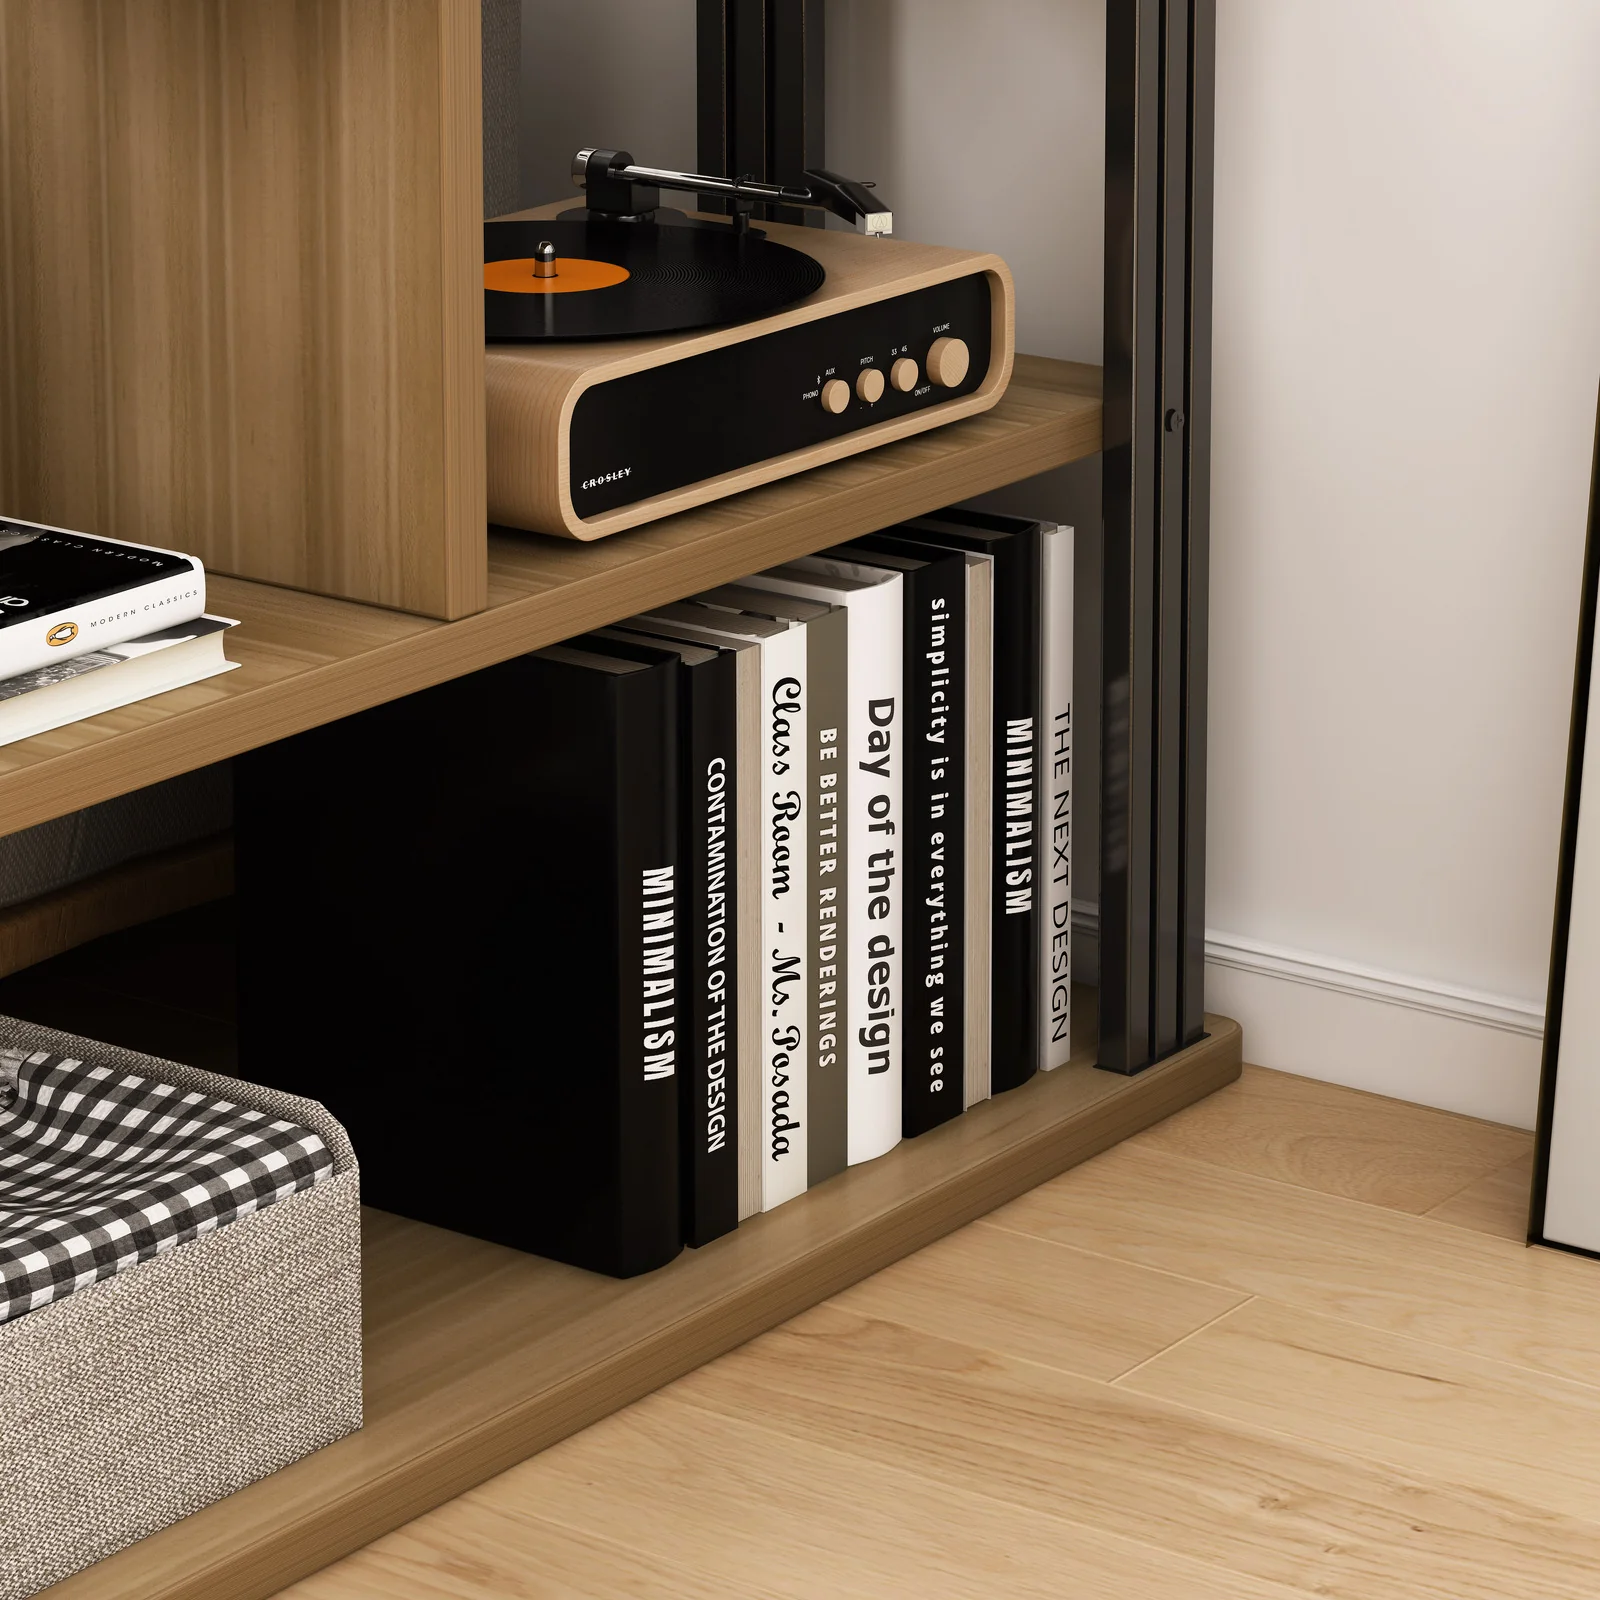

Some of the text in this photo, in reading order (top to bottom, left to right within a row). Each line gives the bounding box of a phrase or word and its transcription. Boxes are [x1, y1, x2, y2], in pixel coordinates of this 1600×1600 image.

[825, 367, 836, 377] AUX
[860, 355, 874, 366] PITCH
[932, 322, 950, 333] VOLUME
[802, 389, 819, 400] PHONO
[914, 385, 931, 397] ON/OFF
[581, 467, 632, 490] CROSLEY
[90, 589, 198, 628] MODERN CLASSICS
[772, 676, 802, 776] Class
[771, 790, 802, 900] Room
[925, 598, 950, 1093] simplicity is in everything we see
[1006, 717, 1033, 915] MINIMALISM
[818, 727, 837, 1068] BE BETTER RENDERINGS
[858, 697, 895, 1075] Day of the design
[1051, 702, 1071, 1043] THE NEXT DESIGN
[642, 865, 675, 1081] MINIMALISM
[707, 757, 726, 1154] CONTAMINATION OF THE DESIGN
[771, 948, 801, 1017] Ms.
[771, 1025, 801, 1162] Posada
